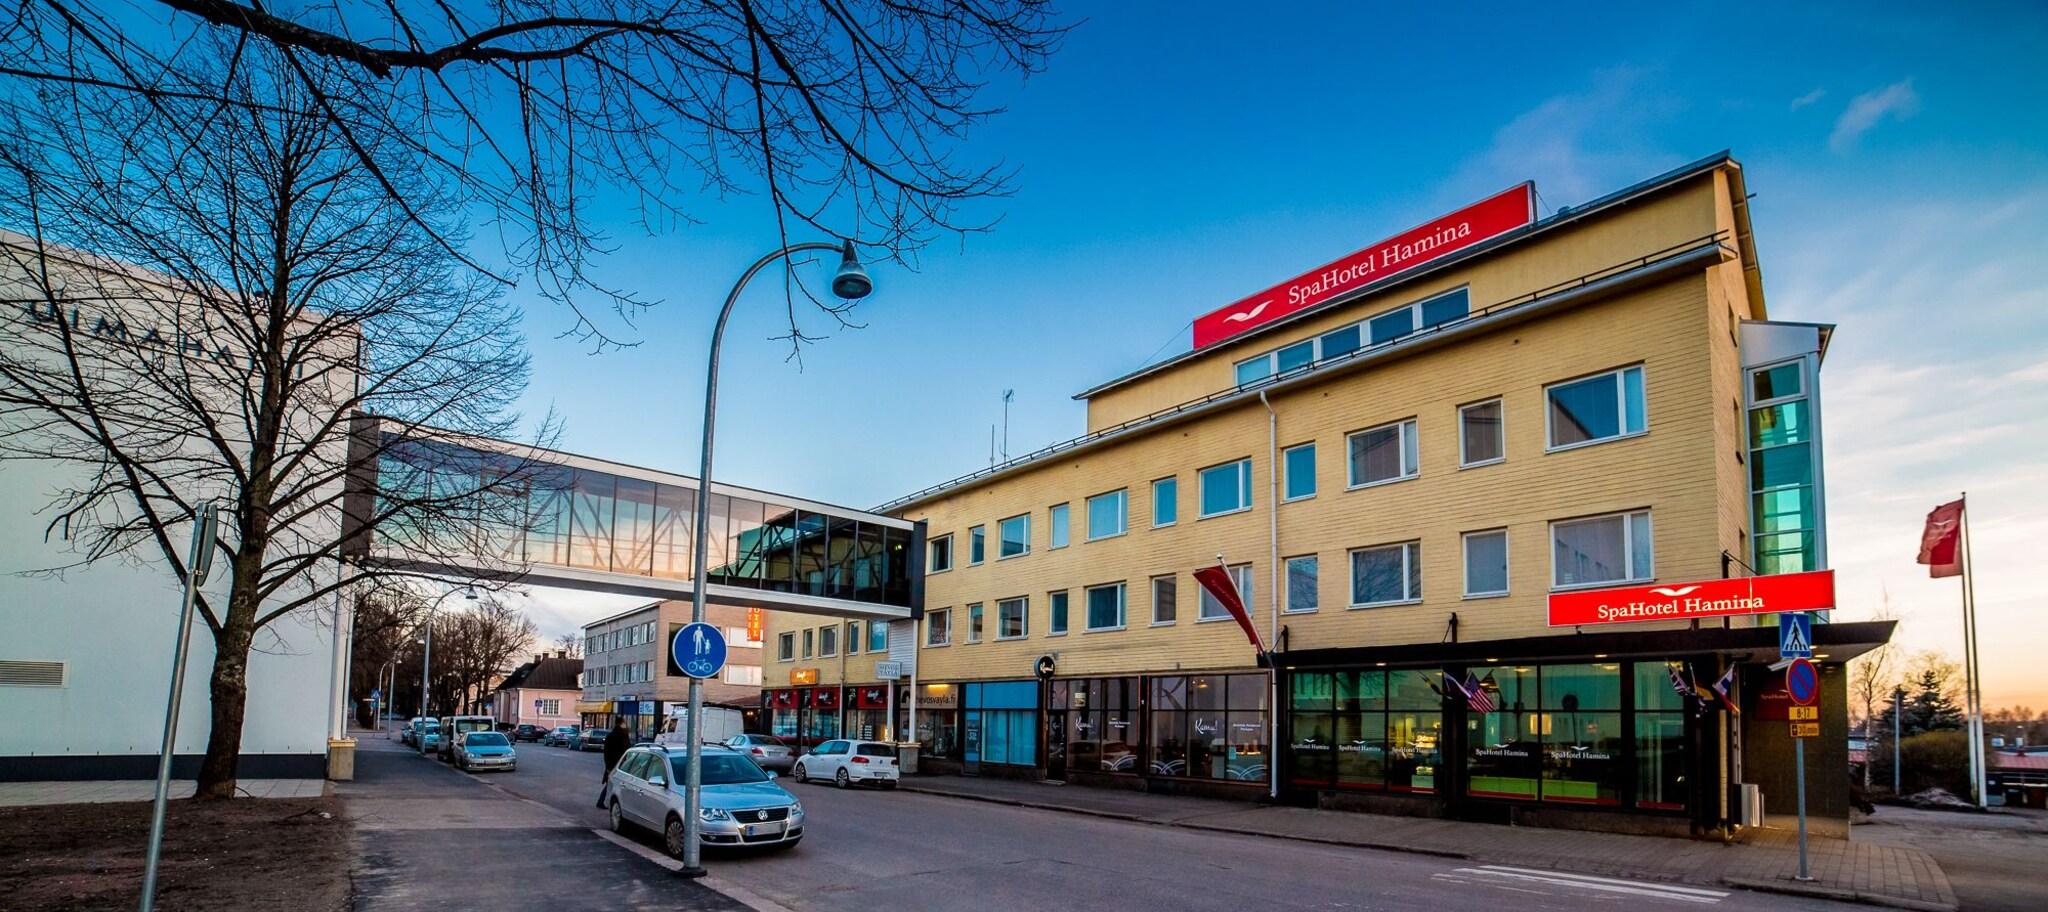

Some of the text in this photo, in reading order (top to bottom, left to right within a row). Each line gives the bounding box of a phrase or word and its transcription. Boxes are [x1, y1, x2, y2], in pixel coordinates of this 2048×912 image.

[1288, 221, 1472, 304] SpaHotel Hamina
[1598, 595, 1764, 620] SpaHotel Hamina
[1475, 748, 1529, 757] SpaHotel Hamina
[1551, 751, 1610, 760] SpaHotel Hamina
